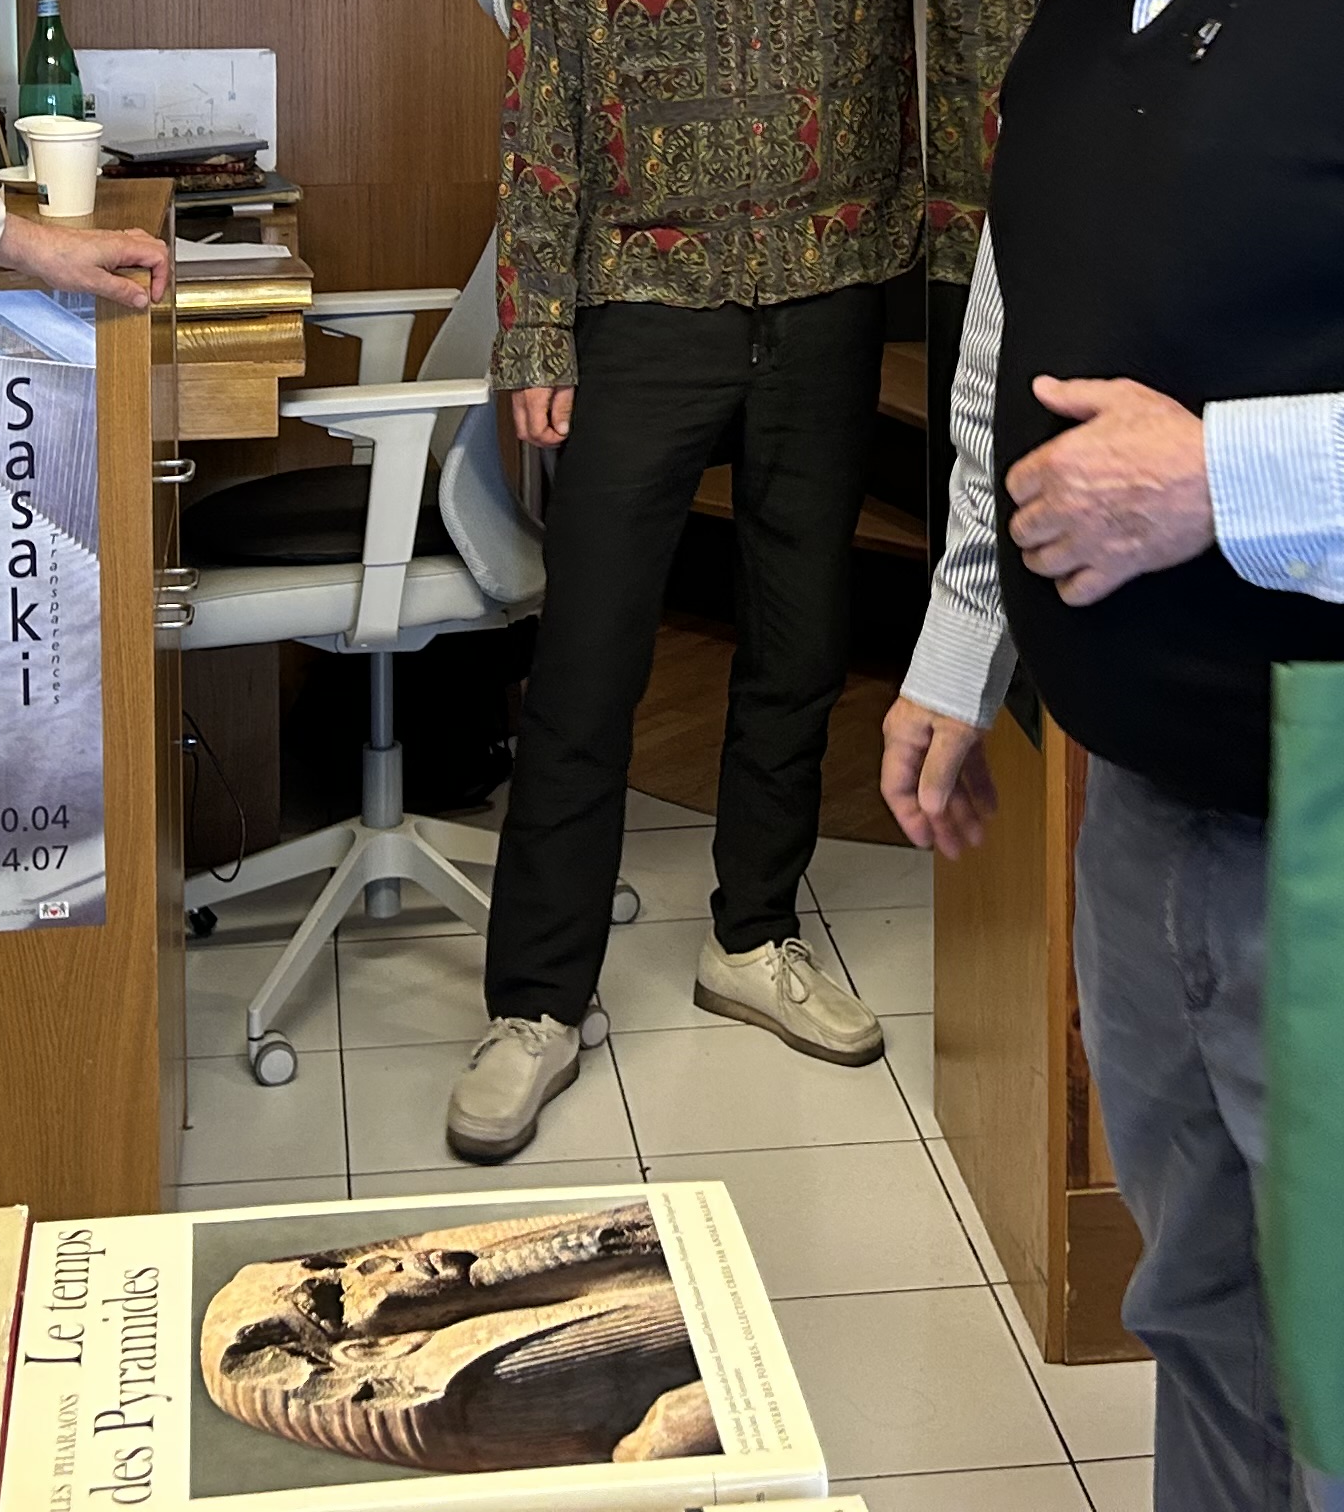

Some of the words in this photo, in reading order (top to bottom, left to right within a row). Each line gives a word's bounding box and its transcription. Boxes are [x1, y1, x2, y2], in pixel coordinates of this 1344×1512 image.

[41, 1228, 107, 1312] temps
[715, 1248, 727, 1265] PAR
[729, 1291, 756, 1341] COLLECTION
[24, 1323, 85, 1368] Le
[93, 1266, 173, 1438] Pyramides
[760, 1381, 775, 1400] DES
[53, 1392, 80, 1477] PHARAONS
[88, 1445, 154, 1505] des
